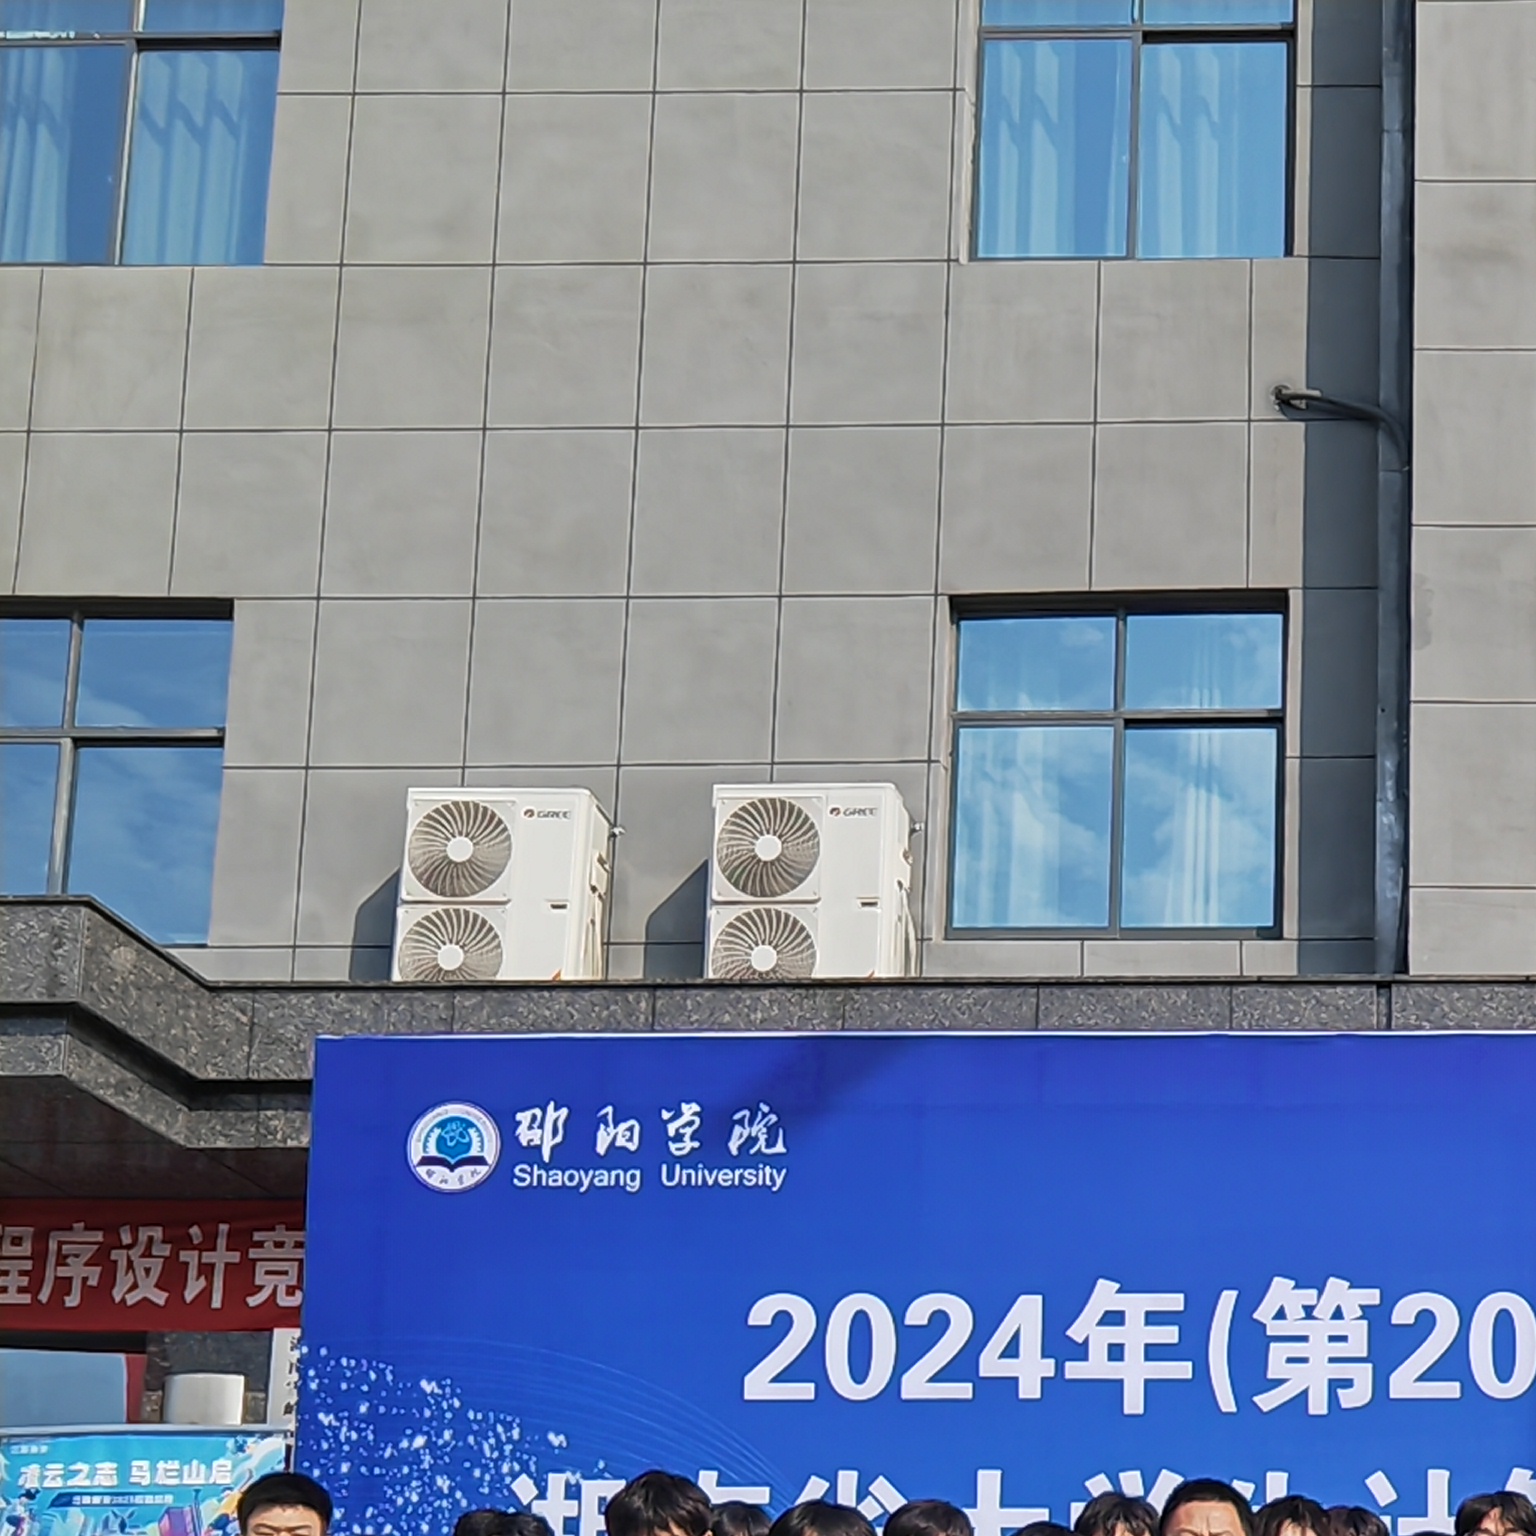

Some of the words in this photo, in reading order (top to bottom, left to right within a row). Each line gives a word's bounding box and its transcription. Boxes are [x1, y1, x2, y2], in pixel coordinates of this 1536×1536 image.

[514, 1101, 787, 1163] 邵阳学院
[513, 1163, 641, 1192] Shaoyang
[661, 1163, 787, 1192] University
